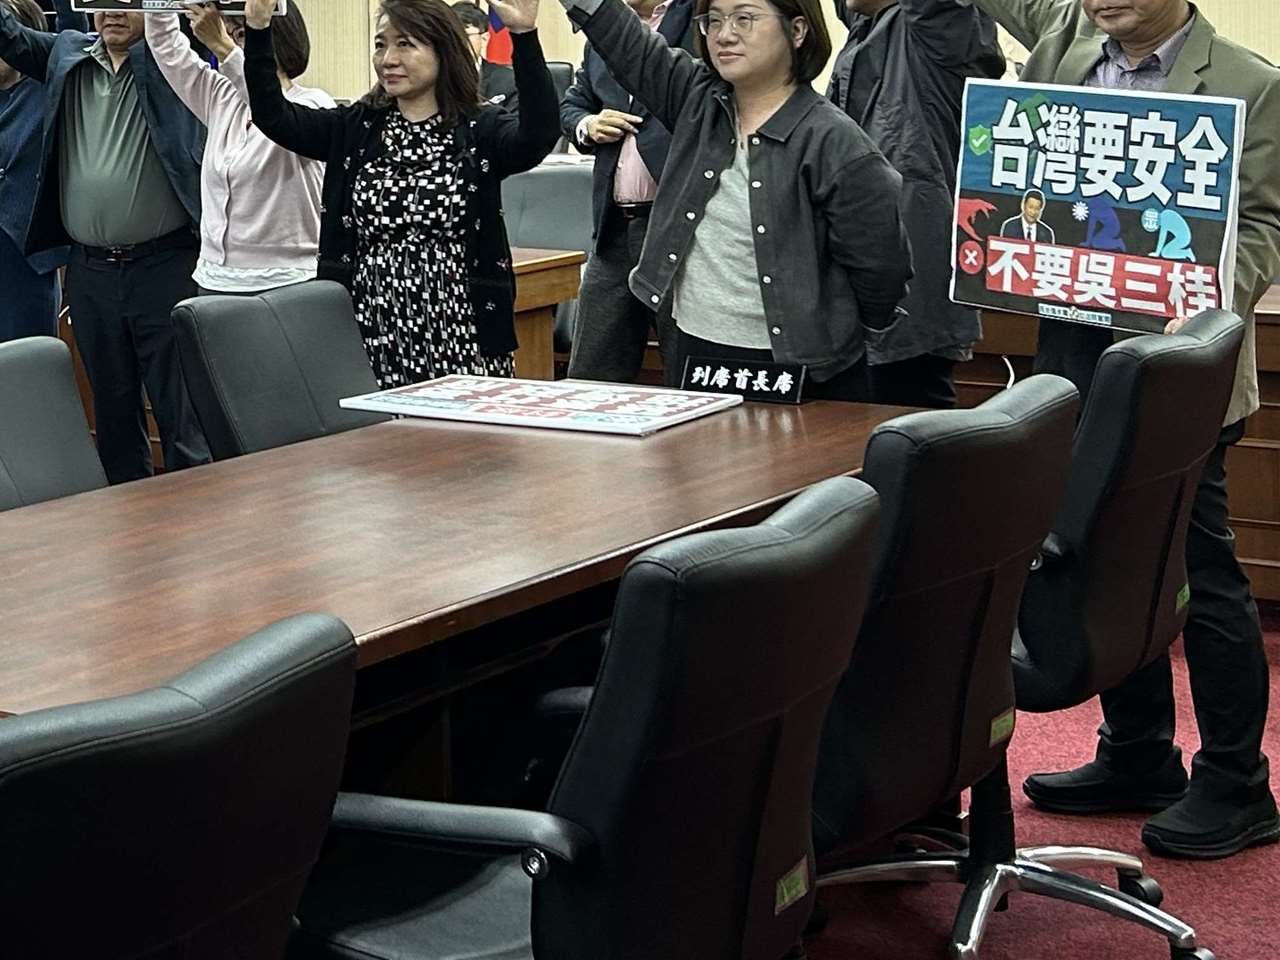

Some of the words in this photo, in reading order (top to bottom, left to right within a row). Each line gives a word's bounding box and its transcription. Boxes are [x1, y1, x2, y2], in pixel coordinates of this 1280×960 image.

[991, 98, 1229, 211] 台灣要安全
[988, 239, 1218, 319] 不要吳三桂
[691, 365, 795, 395] 列席首長席
